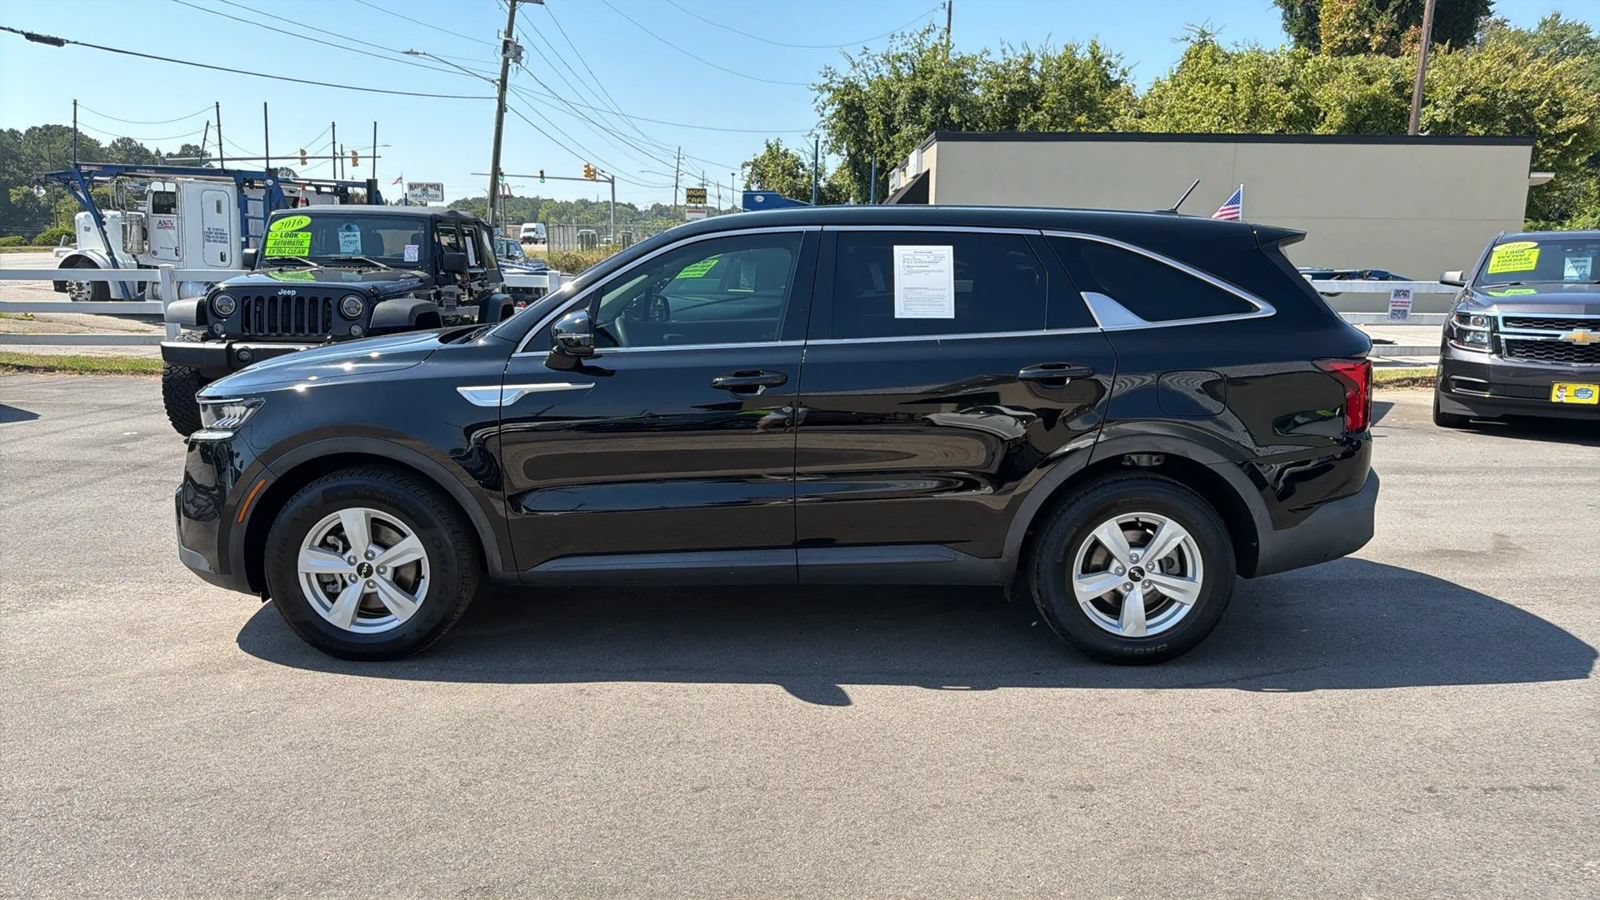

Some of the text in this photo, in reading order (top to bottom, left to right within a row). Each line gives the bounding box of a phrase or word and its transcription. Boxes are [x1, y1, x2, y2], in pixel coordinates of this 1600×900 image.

[277, 217, 304, 230] 2016
[272, 239, 305, 247] AUTOMATIC
[277, 288, 297, 297] Jeep
